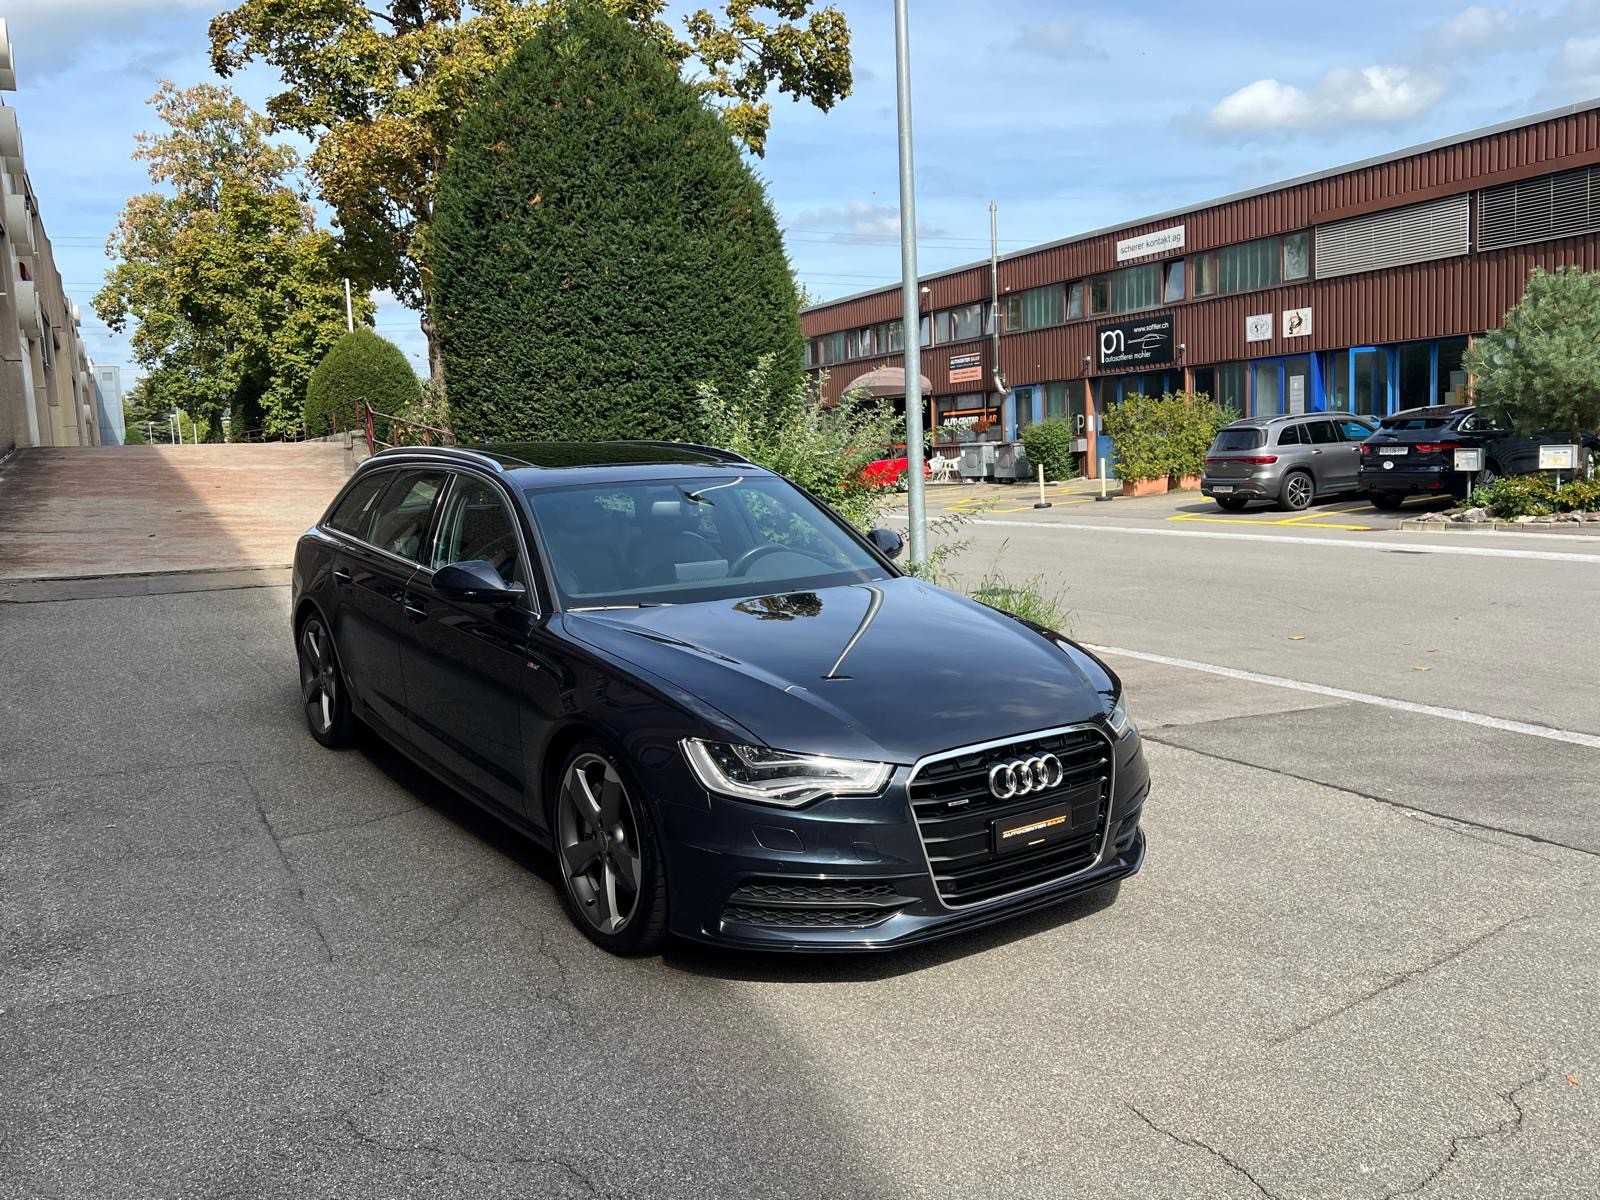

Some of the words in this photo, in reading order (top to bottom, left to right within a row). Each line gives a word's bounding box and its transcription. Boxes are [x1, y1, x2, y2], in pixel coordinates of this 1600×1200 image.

[1120, 242, 1144, 254] scherer
[1145, 235, 1171, 248] kontakt
[1172, 234, 1181, 242] ag
[1133, 322, 1169, 333] www.sattler.ch
[1134, 349, 1151, 359] mohler
[1002, 821, 1047, 838] AUTOCENTER
